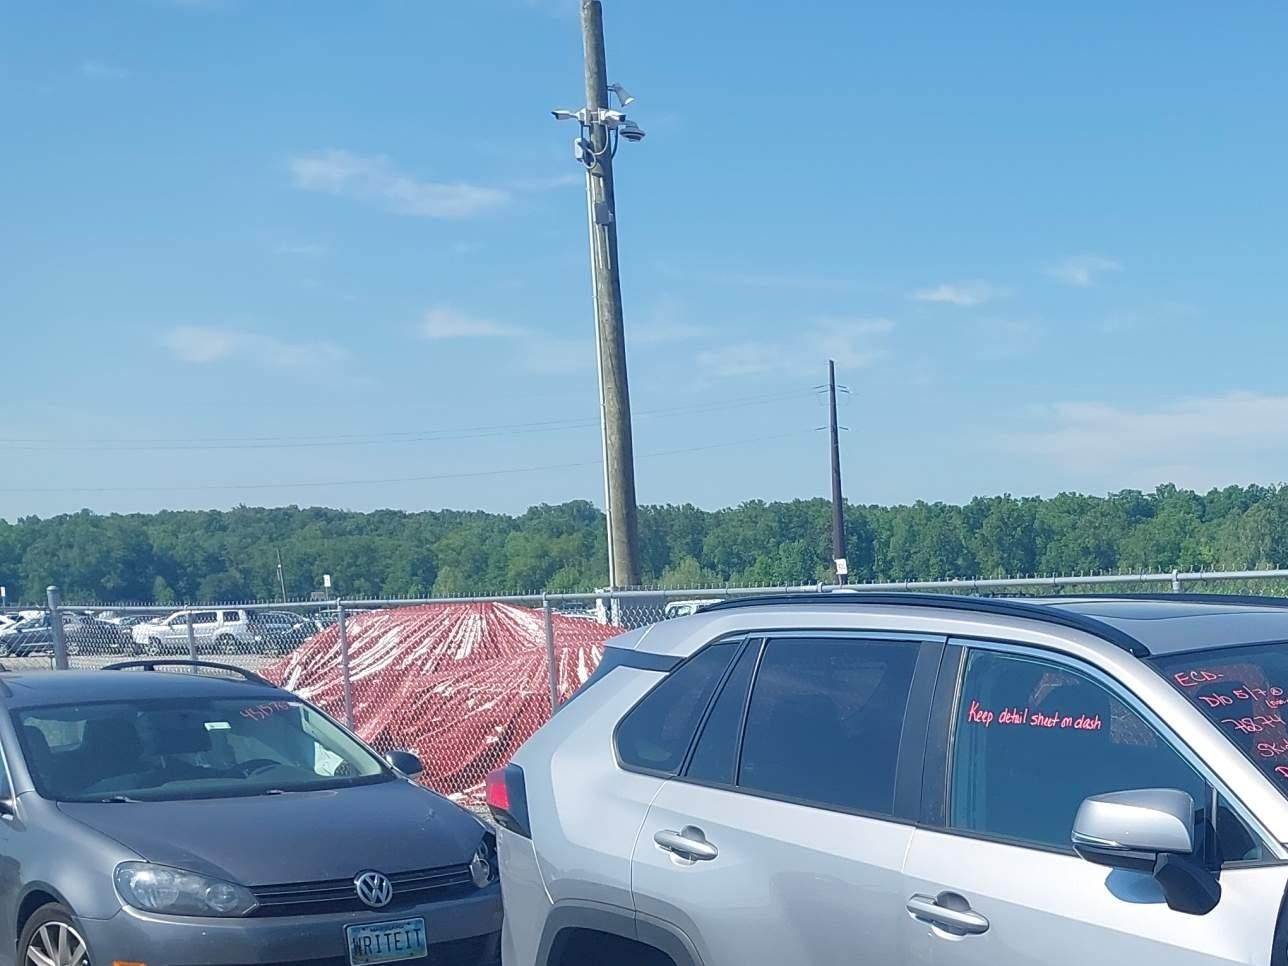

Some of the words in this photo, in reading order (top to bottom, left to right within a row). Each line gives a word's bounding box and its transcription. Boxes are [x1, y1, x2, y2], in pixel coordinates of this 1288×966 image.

[968, 701, 993, 728] Keep
[999, 707, 1027, 725] detail
[1030, 711, 1060, 728] sheet
[1074, 717, 1101, 730] dash
[356, 872, 393, 908] VW
[352, 928, 421, 956] WRITEIT
